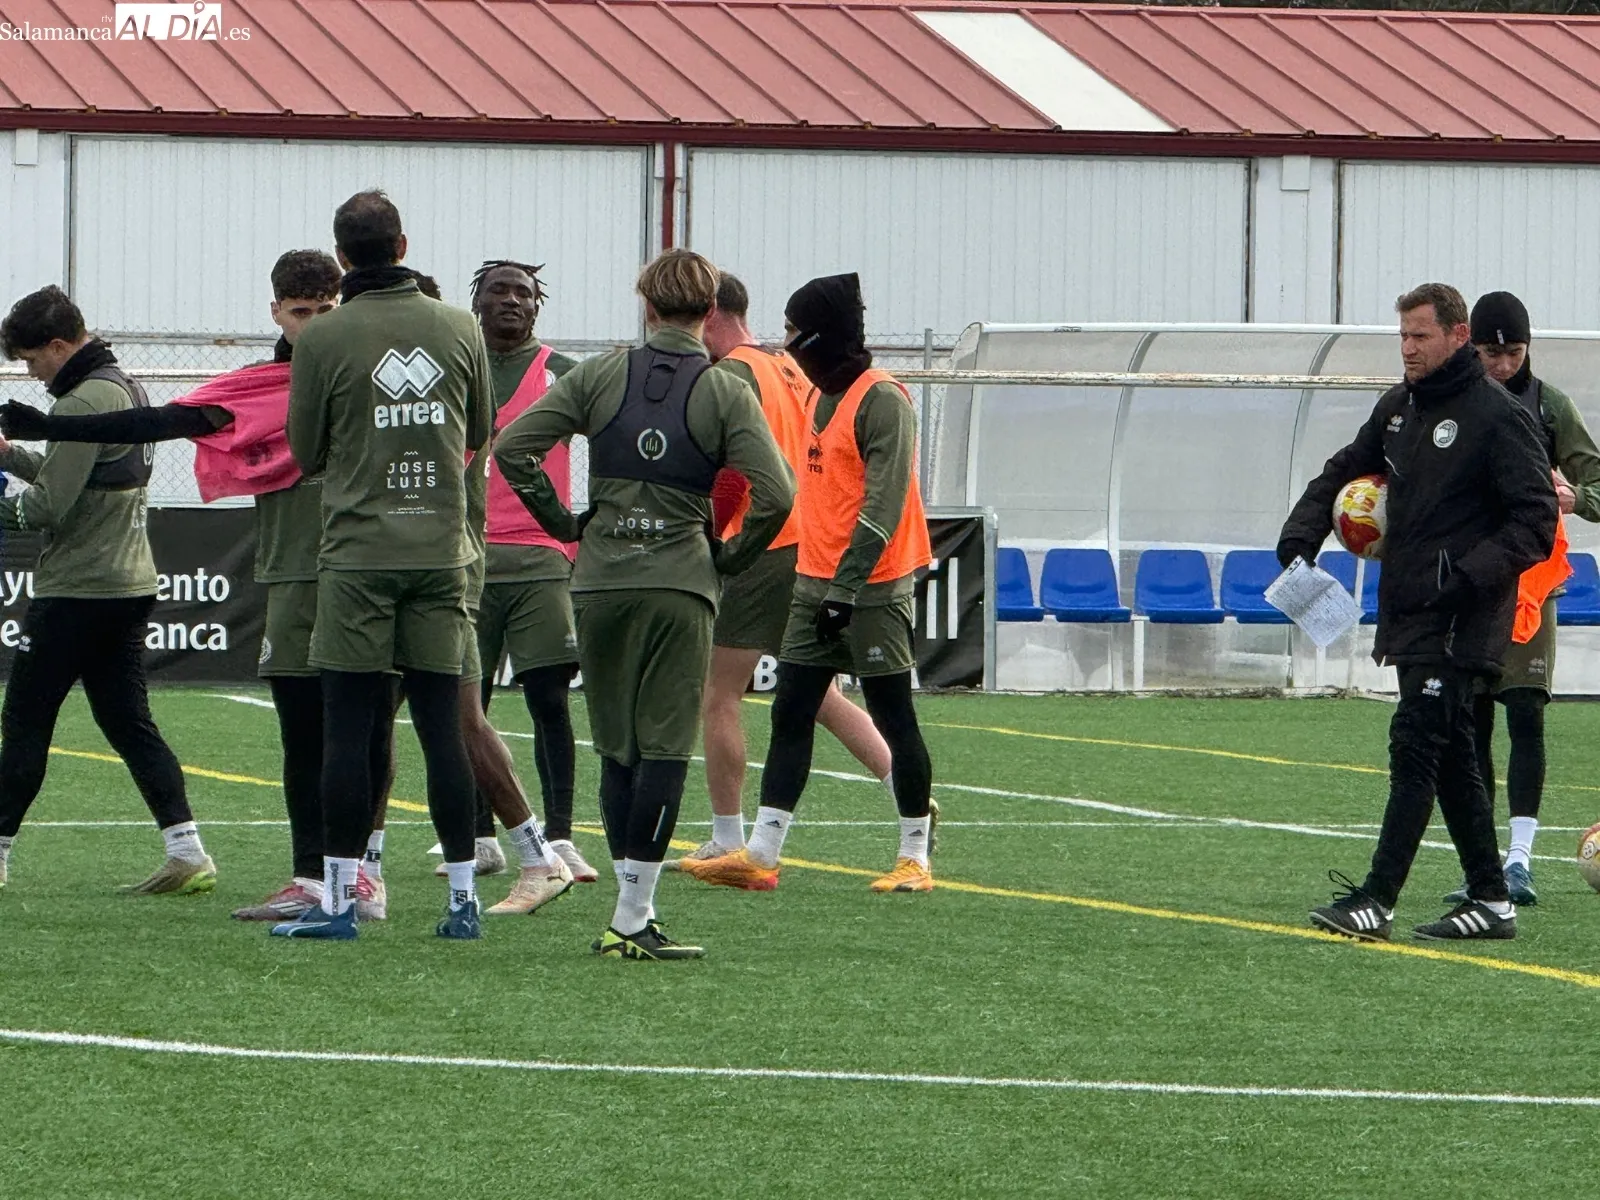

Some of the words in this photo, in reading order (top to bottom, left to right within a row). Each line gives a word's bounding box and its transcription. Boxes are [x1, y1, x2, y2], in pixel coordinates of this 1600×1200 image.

[374, 400, 446, 429] errea
[387, 460, 436, 475] JOSE
[387, 475, 436, 489] LUIS
[156, 567, 230, 602] ento
[144, 622, 228, 651] anca
